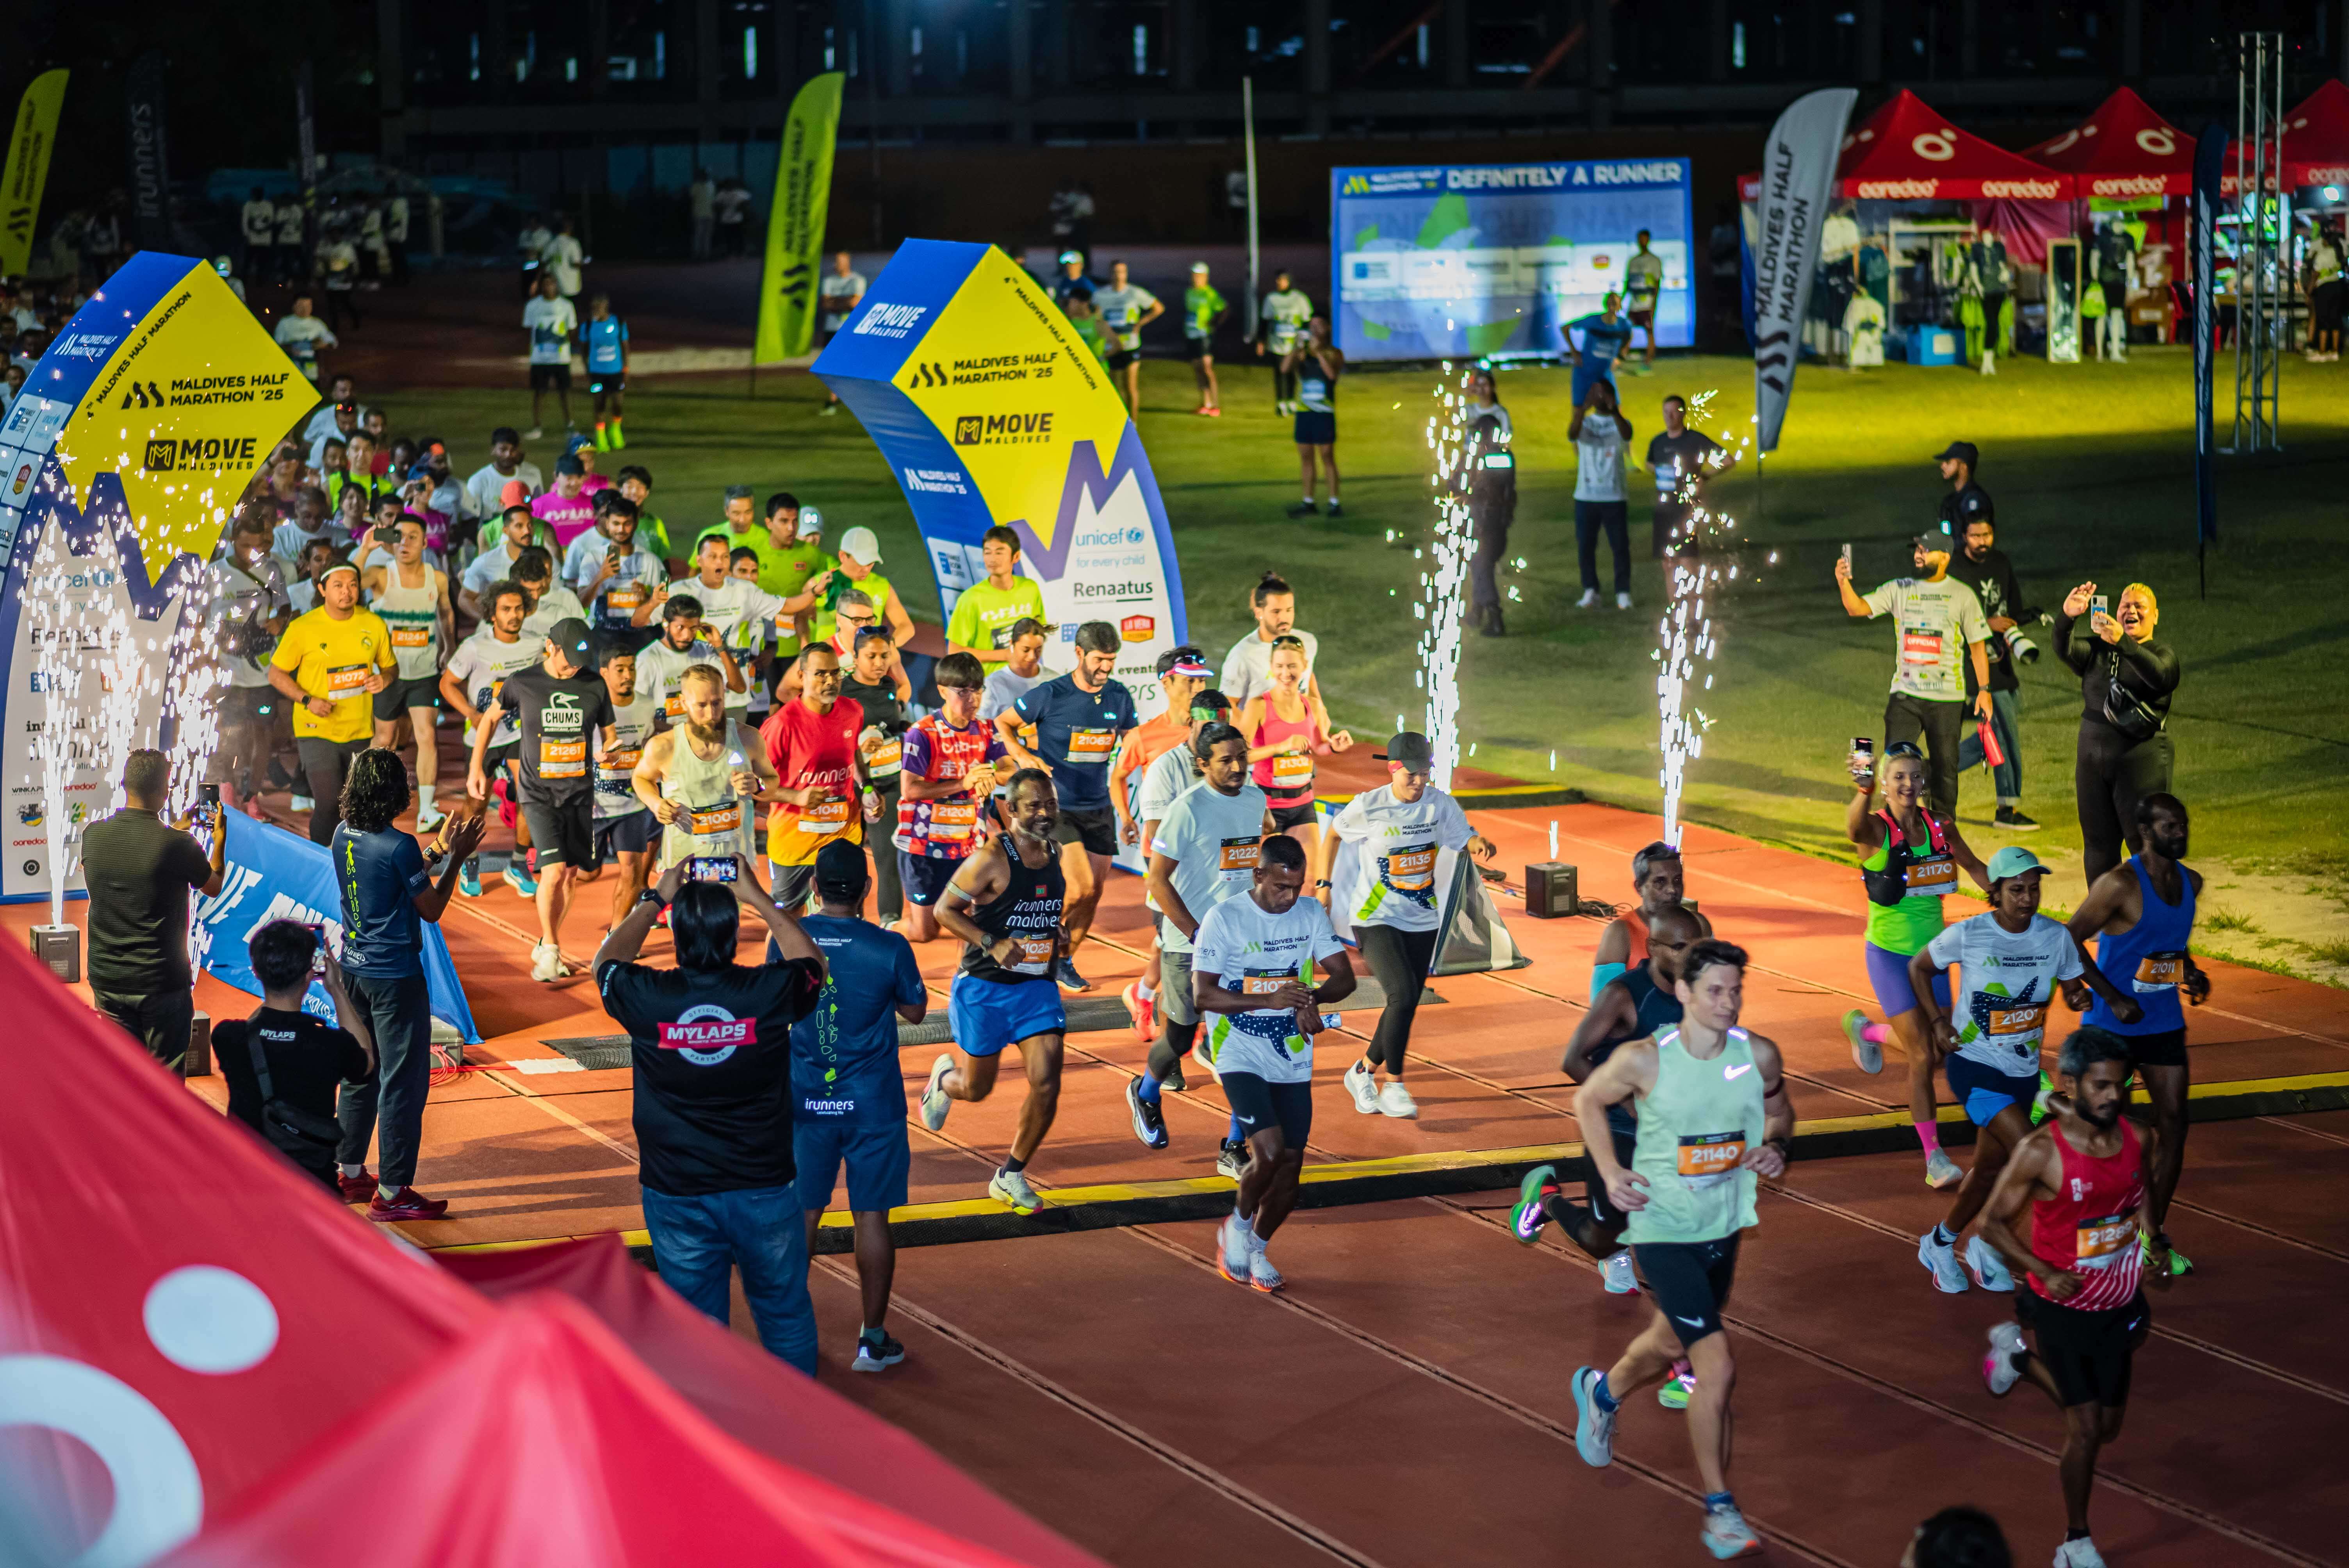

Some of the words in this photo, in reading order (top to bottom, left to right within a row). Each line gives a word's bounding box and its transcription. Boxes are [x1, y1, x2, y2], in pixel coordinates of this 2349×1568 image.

[1447, 167, 1566, 189] DEFINITELY
[1572, 166, 1589, 184] A
[1594, 162, 1682, 183] RUNNER
[1858, 178, 1940, 198] ooredoo
[1981, 178, 2061, 198] ooredoo
[1756, 212, 1785, 318] MALDIVES
[1773, 141, 1795, 201] HALF
[1779, 198, 1809, 324] MARATHON
[882, 304, 927, 329] MOVE
[868, 327, 908, 339] MALDIVES
[1014, 287, 1050, 325] MALDIVES
[1048, 324, 1066, 344] HALF
[1064, 345, 1098, 391] MARATHON
[96, 359, 131, 404] MALDIVES
[128, 336, 149, 360] HALF
[148, 291, 192, 338] MARATHON
[953, 356, 1020, 371] MALDIVES
[1024, 352, 1059, 365] HALF
[171, 376, 246, 391] MALDIVES
[251, 373, 290, 387] HALF
[953, 369, 1027, 385] MARATHON
[170, 390, 255, 407] MARATHON
[260, 389, 284, 401] '25
[986, 413, 1054, 434] MOVE
[984, 435, 1051, 445] MALDIVES
[180, 438, 257, 460] MOVE
[178, 461, 253, 472] MALDIVES
[1076, 528, 1124, 547] unicef
[1076, 556, 1090, 567] for
[1092, 556, 1120, 568] every
[1122, 554, 1146, 565] child
[1074, 581, 1153, 597] Renaatus
[1907, 637, 1937, 647] OFFICIAL
[334, 671, 365, 683] 21072
[1118, 665, 1157, 675] events
[545, 711, 580, 723] CHUMS
[1077, 735, 1112, 746] 21062
[550, 746, 581, 755] 21261
[620, 754, 637, 762] 152
[699, 810, 738, 826] 21008
[1402, 828, 1432, 836] MARATHON
[13, 838, 47, 846] ooredoo
[1002, 835, 1019, 862] irunners
[1228, 846, 1258, 860] 21222
[1399, 853, 1431, 867] 21135
[1917, 862, 1952, 878] 21170
[1013, 898, 1062, 912] irunners
[1022, 939, 1050, 954] 1025
[1263, 944, 1297, 952] MARATHON
[1264, 937, 1293, 946] MALDIVES
[2150, 962, 2175, 974] 21011
[1251, 980, 1293, 993] 2107
[688, 1008, 722, 1018] OFFICIAL
[260, 1028, 296, 1039] MYLAPS
[667, 1023, 747, 1040] MYLAPS
[690, 1052, 726, 1062] PARTNER
[805, 1098, 854, 1110] irunners
[1691, 1145, 1738, 1164] 21140
